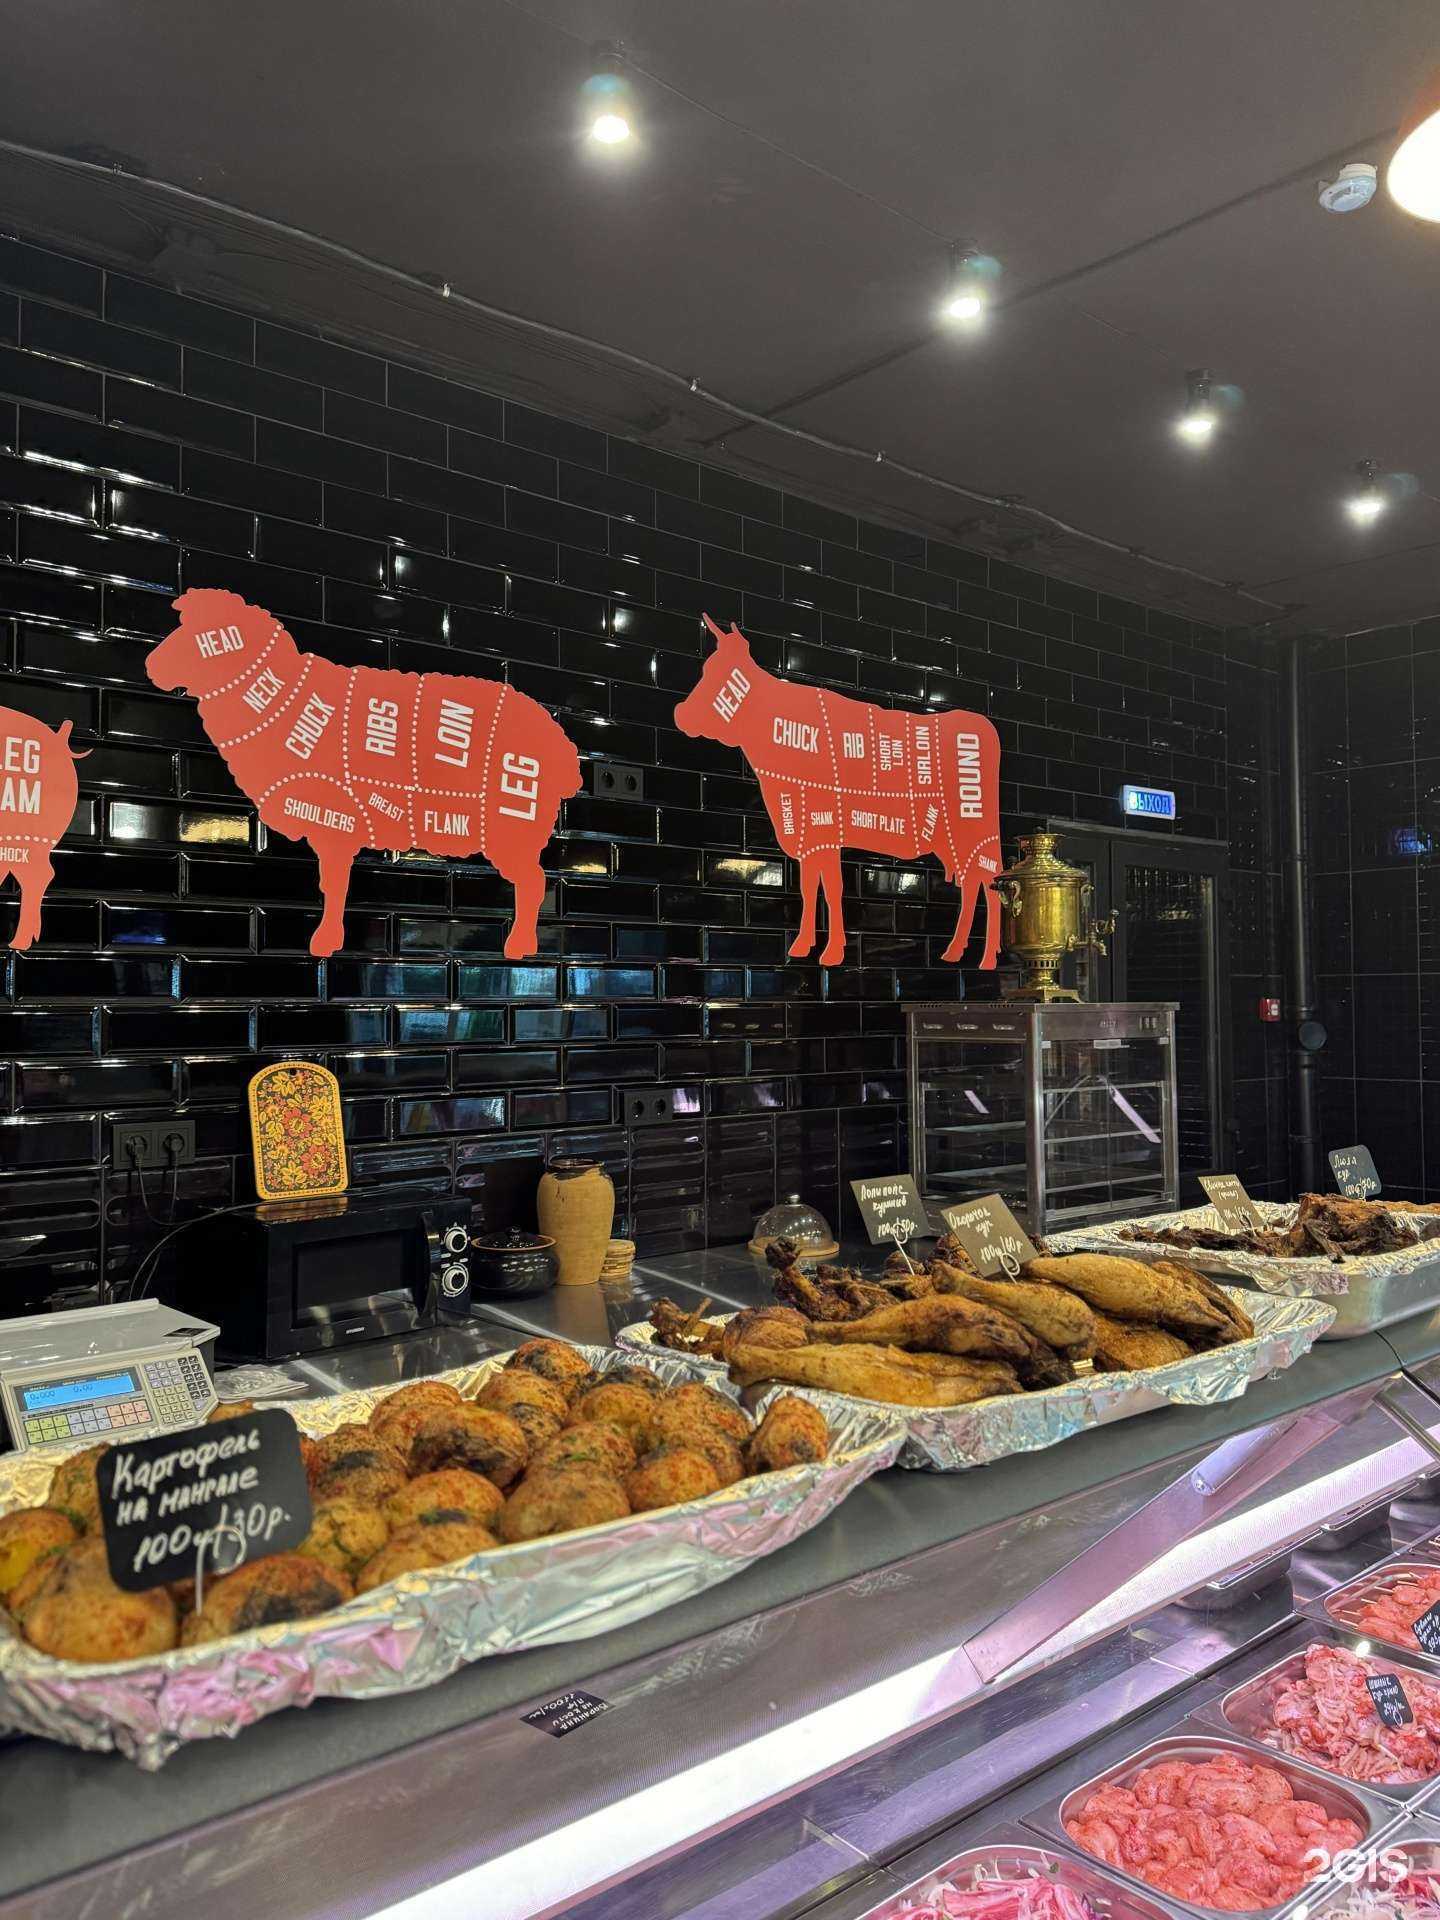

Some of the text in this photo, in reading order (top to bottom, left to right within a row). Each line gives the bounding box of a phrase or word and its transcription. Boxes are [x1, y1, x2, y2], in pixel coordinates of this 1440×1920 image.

[195, 625, 244, 658] HEAD
[242, 667, 286, 714] NECK
[712, 667, 751, 723] HEAD
[285, 692, 336, 760] CHUCK
[365, 698, 399, 757] RIBS
[434, 699, 475, 768] LOIN
[773, 717, 819, 754] CHUCK
[0, 736, 41, 774] EG
[843, 732, 865, 759] RIB
[879, 732, 892, 771] SHORT
[892, 740, 903, 766] LOIN
[915, 726, 932, 785] SIRLOIN
[499, 752, 540, 821] LEG
[957, 733, 983, 818] ROUND
[284, 797, 356, 833] SHOULDERS
[368, 792, 405, 822] BREAST
[780, 792, 794, 835] BRISKET
[810, 811, 834, 826] SHANK
[1129, 791, 1170, 813] ВЫХОД
[424, 811, 470, 837] FLANK
[851, 809, 906, 835] SHORT PLATE
[921, 803, 939, 842] FLANK
[978, 854, 998, 873] SHANK
[111, 1428, 260, 1500] Картофель
